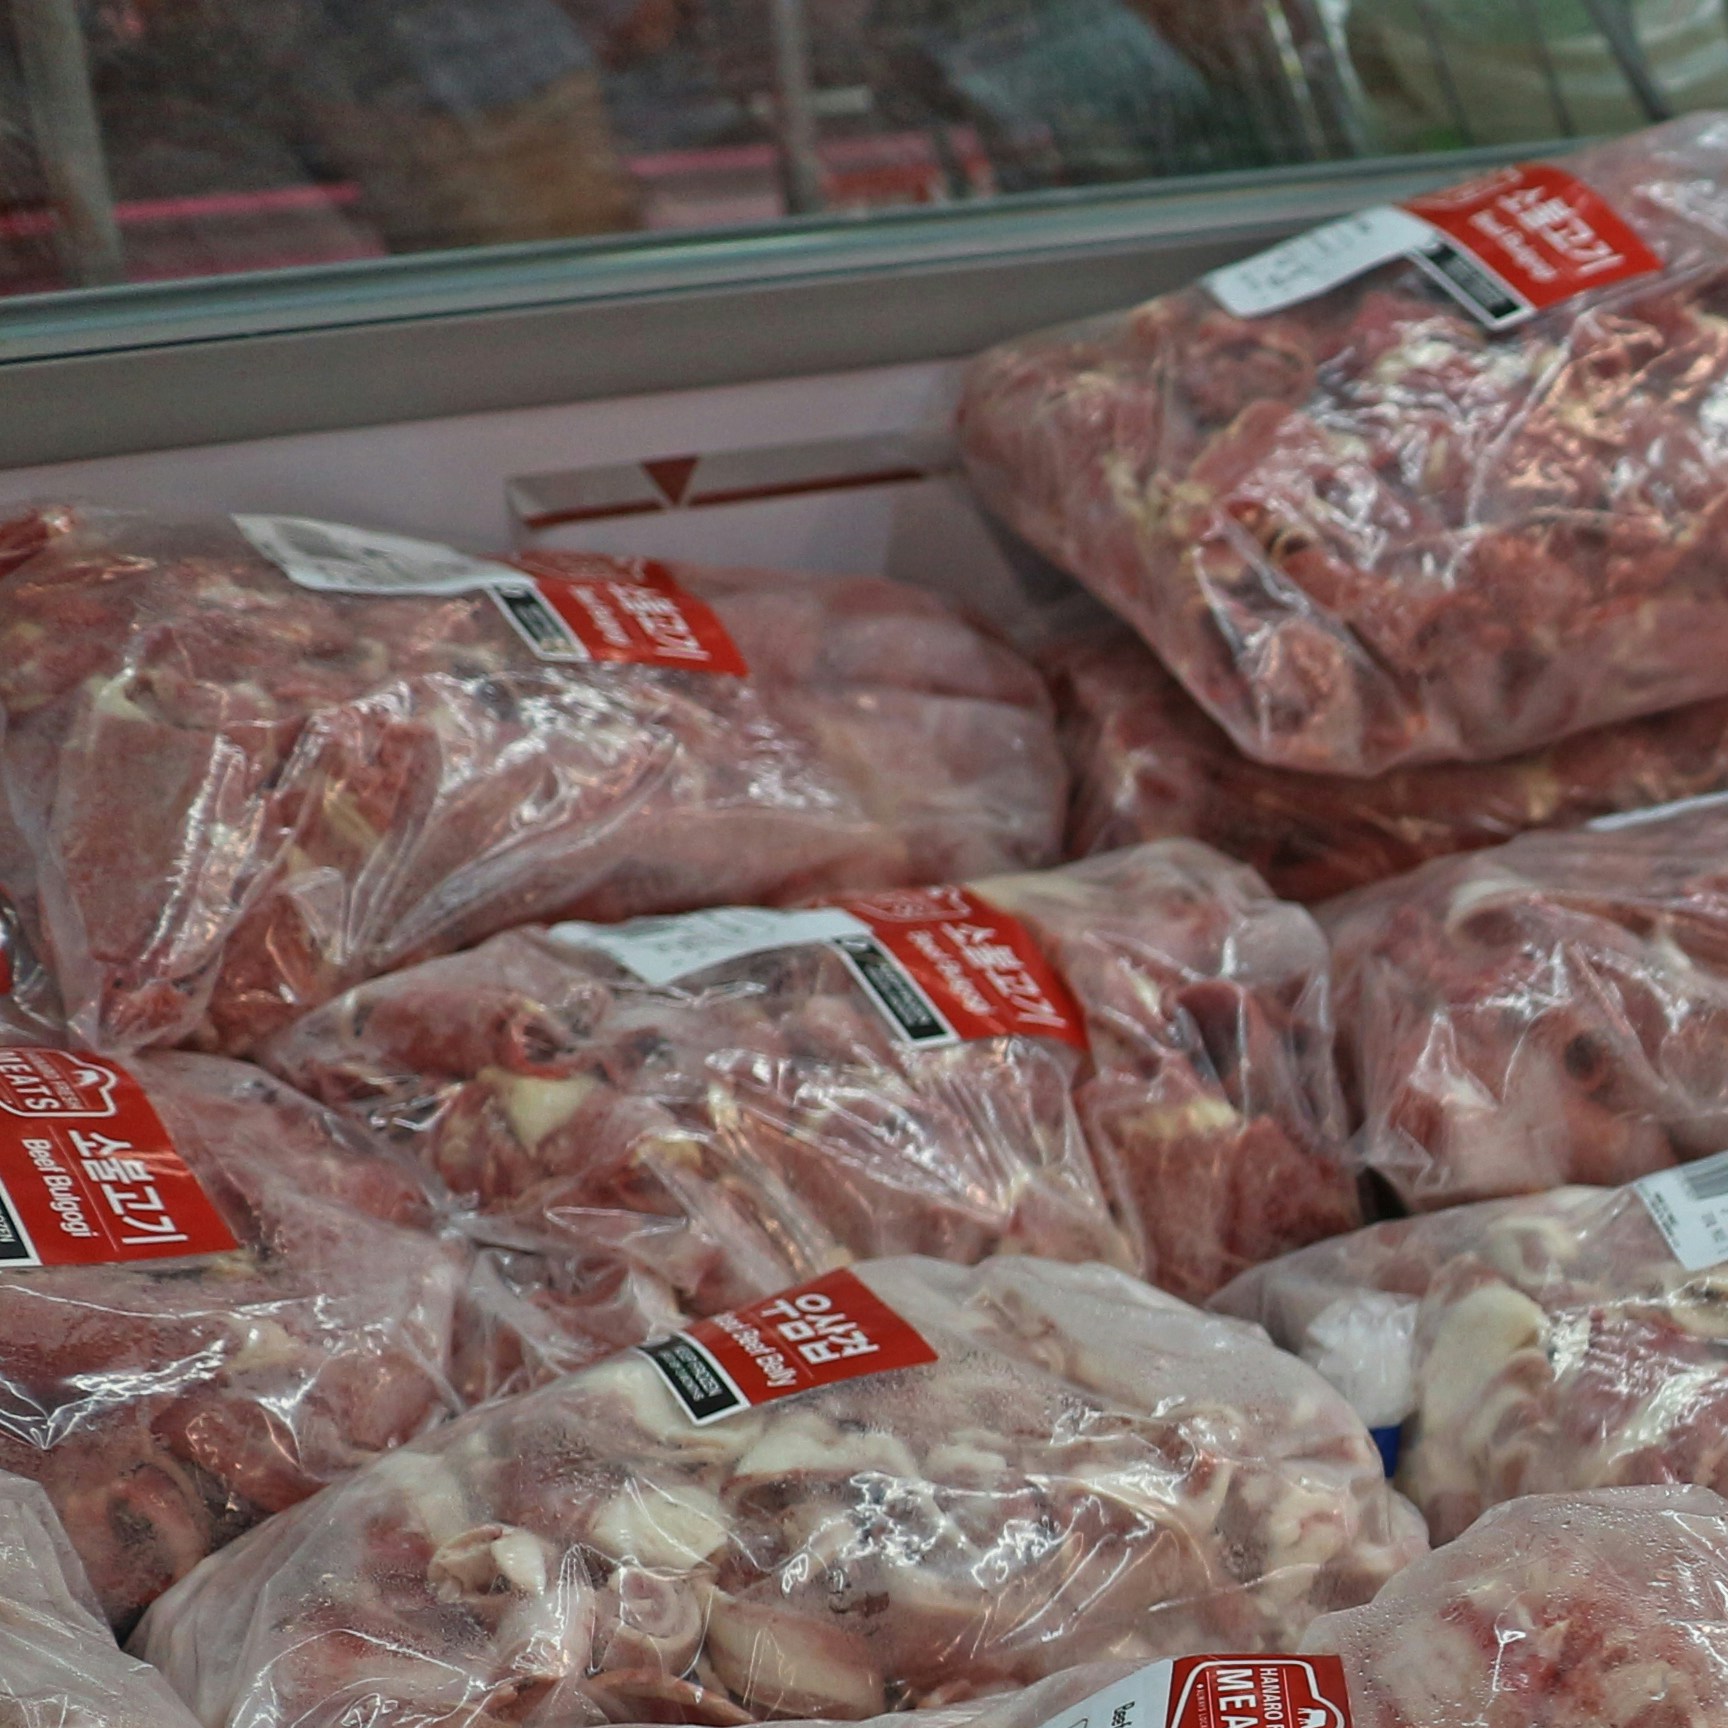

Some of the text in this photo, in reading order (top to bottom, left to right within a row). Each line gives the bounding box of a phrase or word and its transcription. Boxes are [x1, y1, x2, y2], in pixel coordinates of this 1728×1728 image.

[22, 1138, 99, 1237] Beef Bulgogi
[68, 1129, 189, 1244] 소불고기
[760, 1292, 880, 1365] 우삼겹
[1259, 1667, 1284, 1722] HANARO
